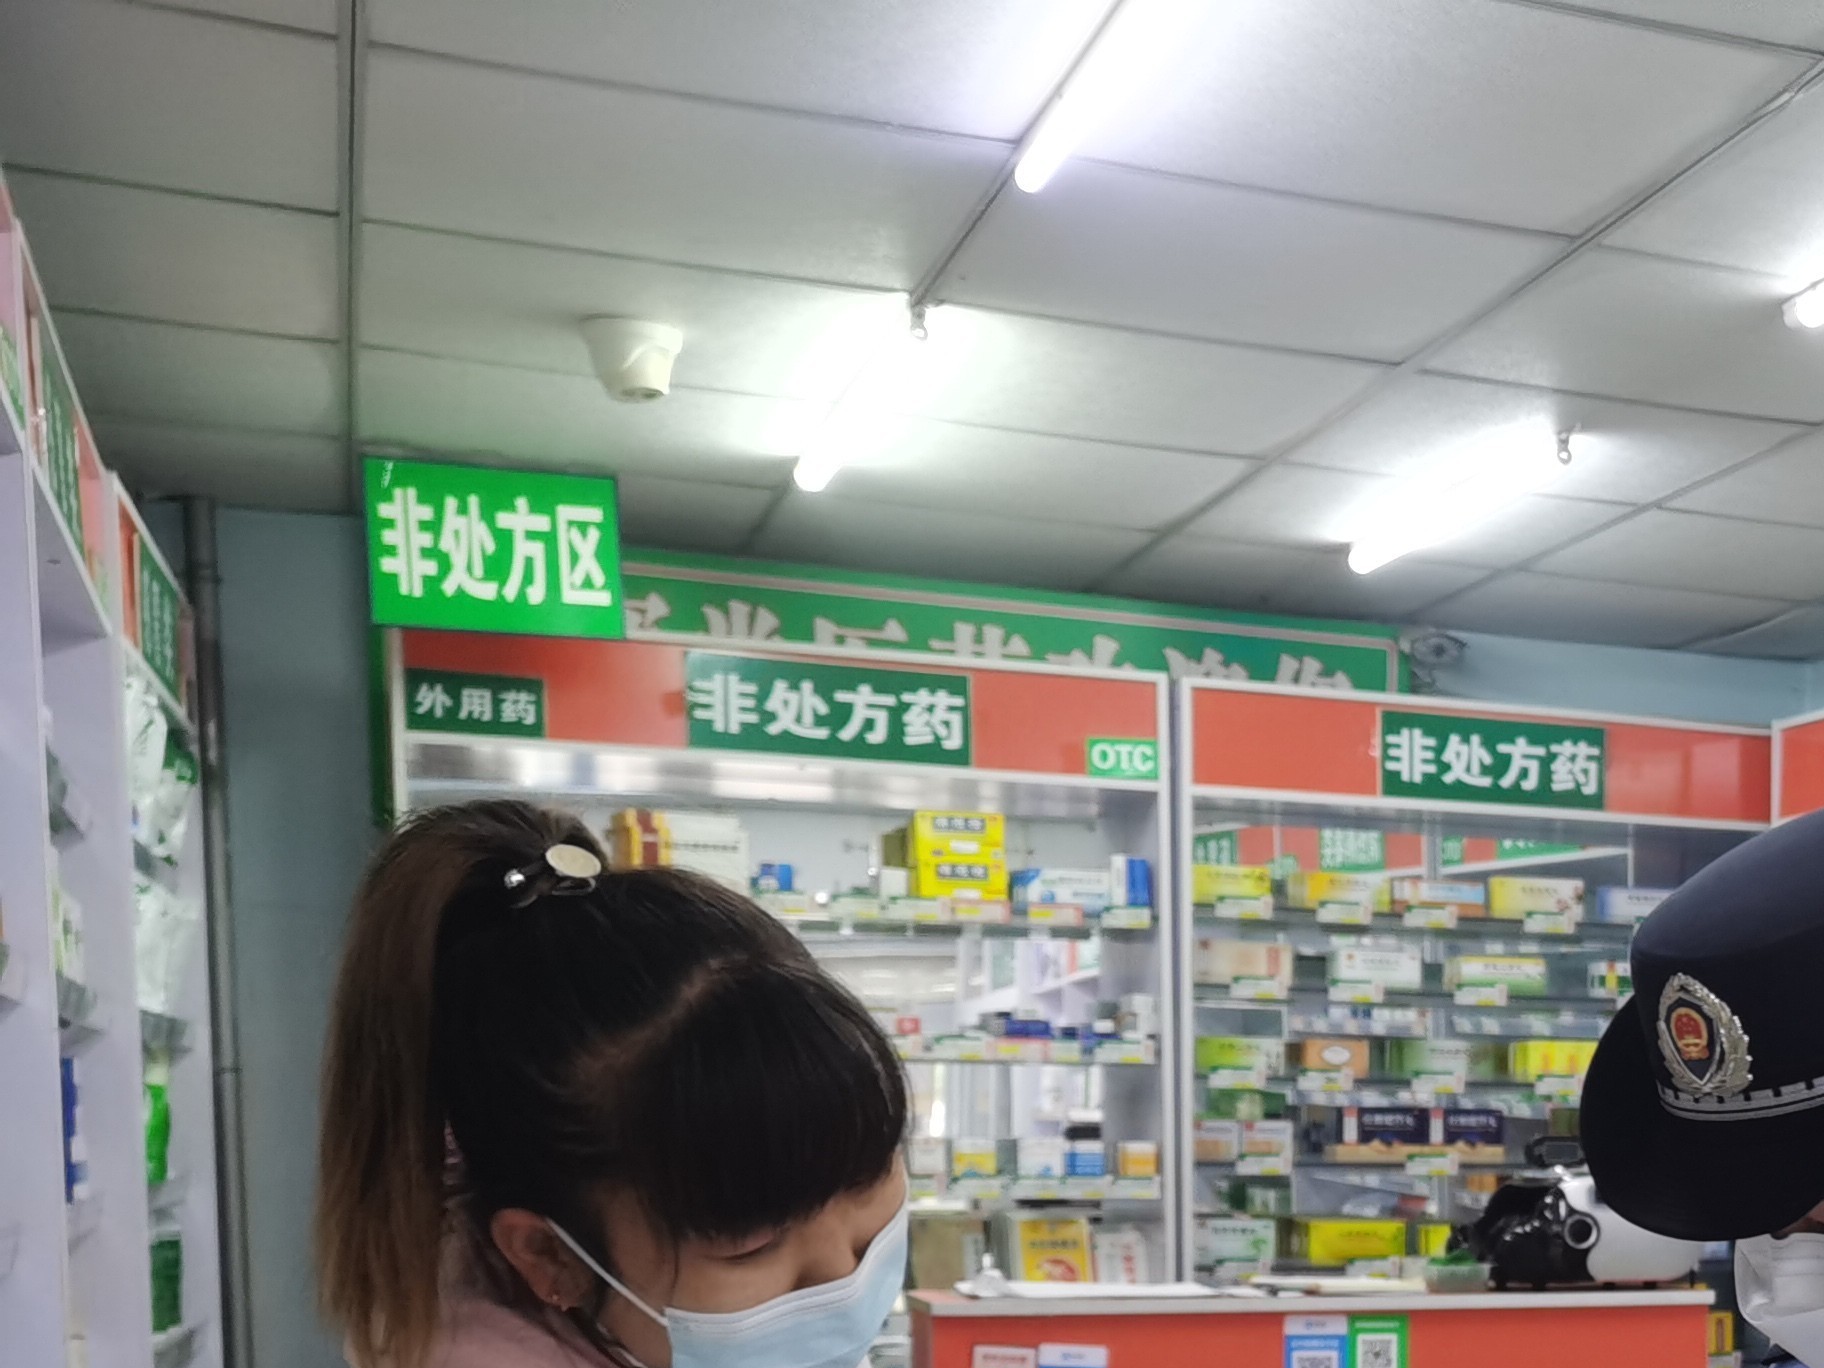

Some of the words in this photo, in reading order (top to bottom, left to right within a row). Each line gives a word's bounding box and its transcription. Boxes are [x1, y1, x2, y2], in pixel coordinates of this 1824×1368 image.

[376, 486, 613, 607] 非处方区
[414, 682, 537, 725] 外用药
[692, 671, 965, 750] 非处方药
[1091, 742, 1155, 771] OTC
[1384, 726, 1600, 796] 非处方药
